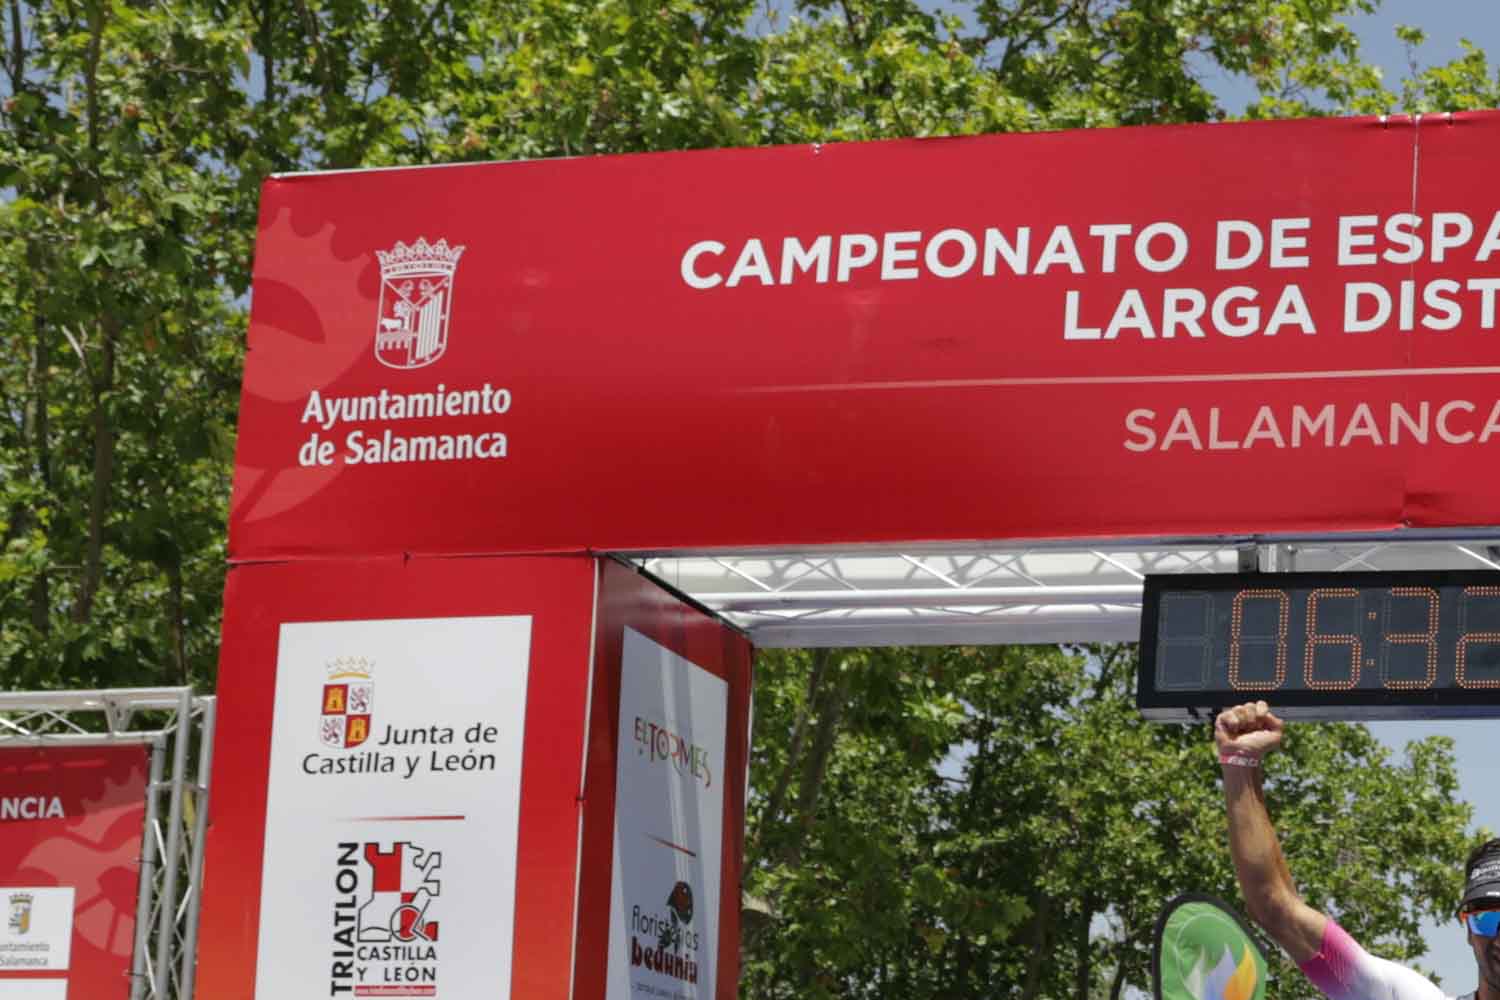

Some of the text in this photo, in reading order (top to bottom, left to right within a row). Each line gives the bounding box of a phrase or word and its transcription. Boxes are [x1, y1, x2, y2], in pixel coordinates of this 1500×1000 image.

[680, 221, 1189, 289] CAMPEONATO
[1214, 217, 1311, 271] DE
[1063, 284, 1317, 340] LARGA
[302, 383, 512, 431] Ayuntamiento
[299, 431, 508, 467] de Salamanca
[378, 722, 499, 747] Junta de
[302, 750, 497, 779] Castilla y León
[331, 842, 360, 997] TRIATLON
[357, 945, 437, 961] CASTILLA
[357, 962, 436, 982] Y LEÓN
